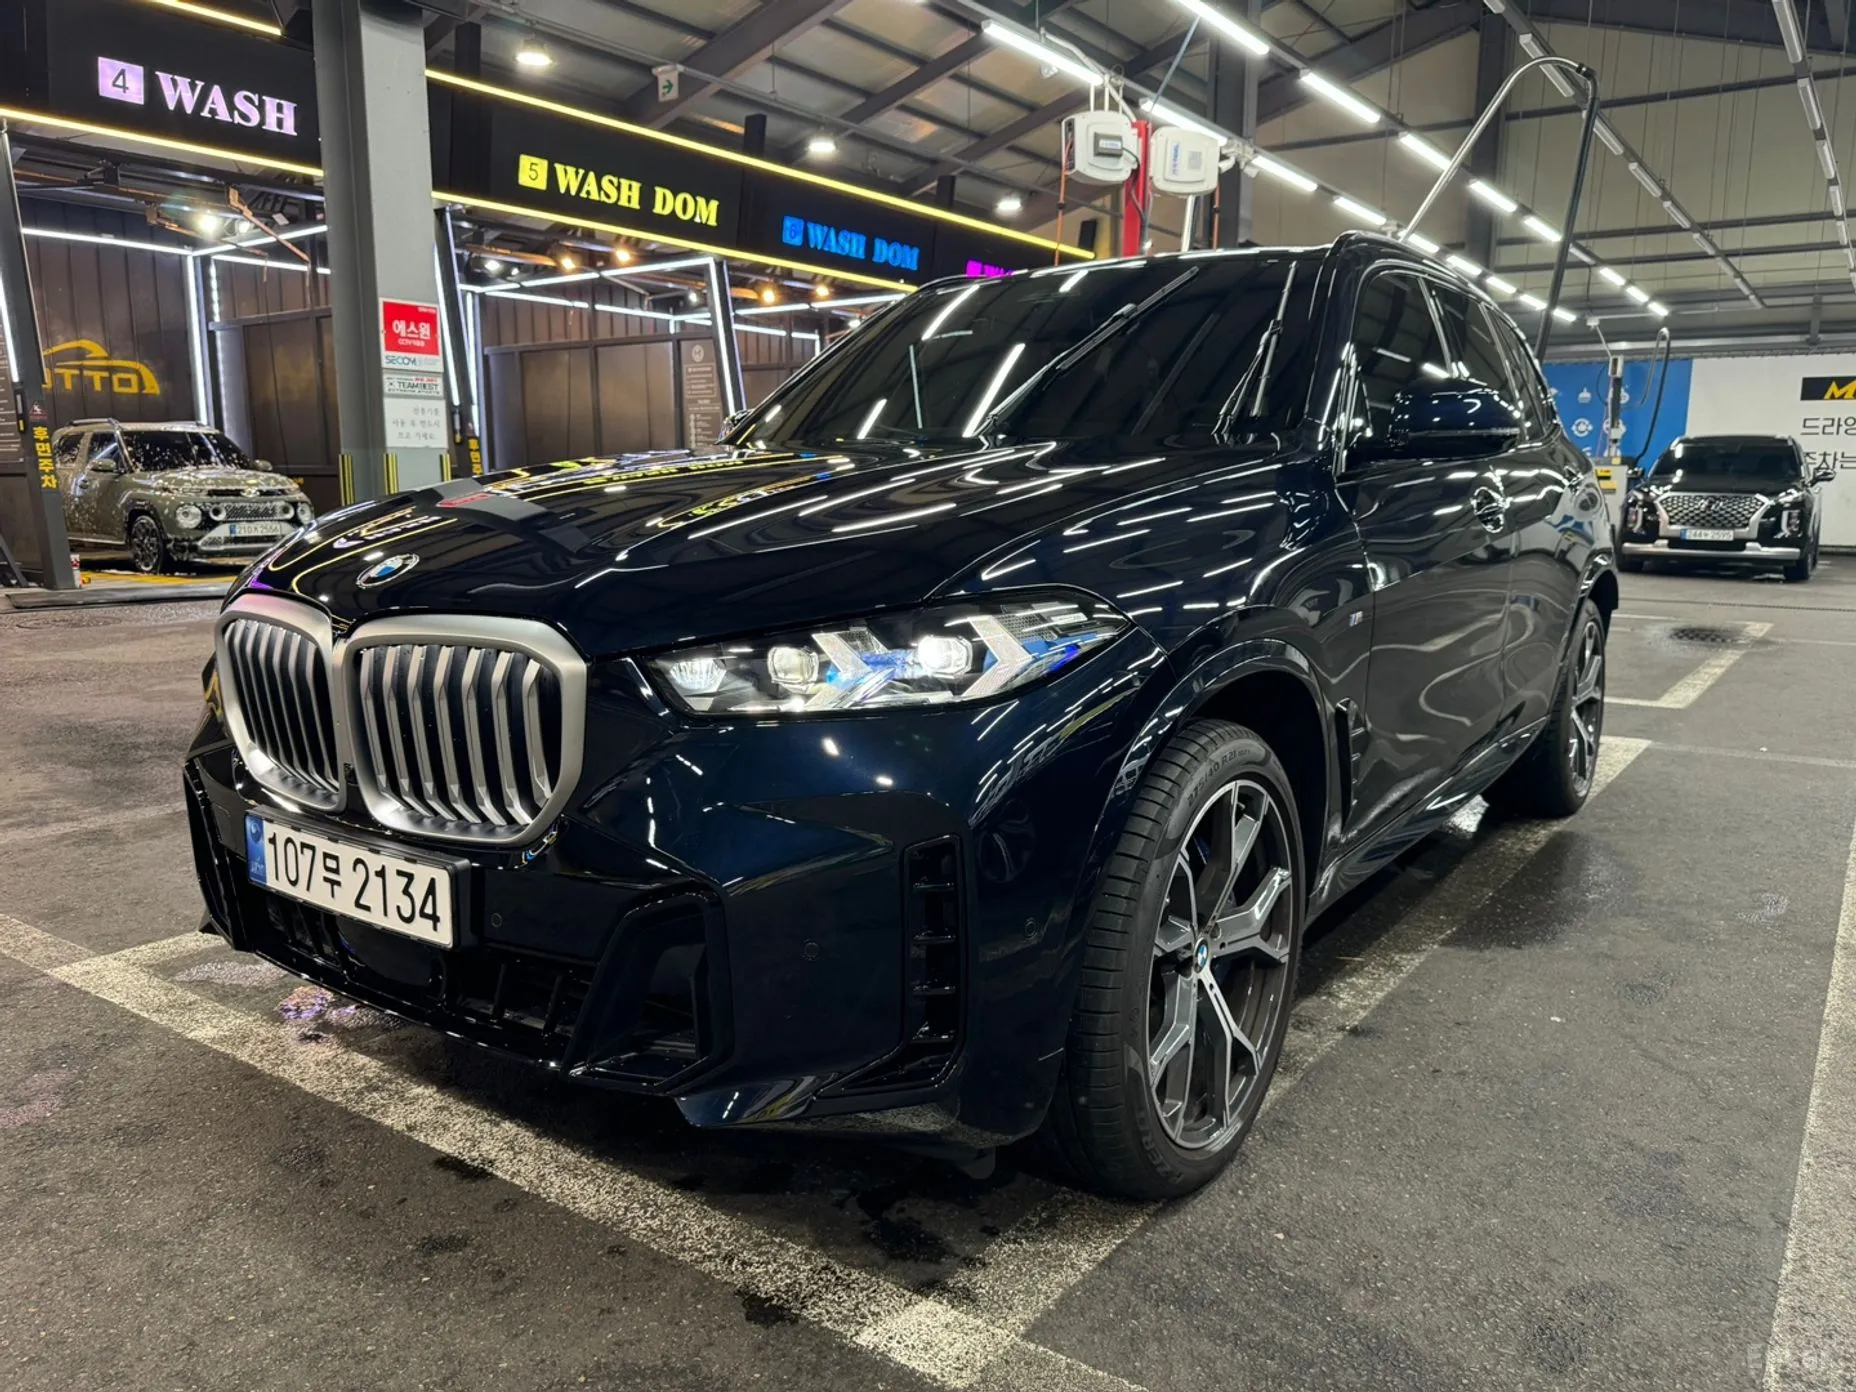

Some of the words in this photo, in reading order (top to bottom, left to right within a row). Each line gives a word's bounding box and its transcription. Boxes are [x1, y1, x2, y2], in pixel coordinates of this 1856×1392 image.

[111, 68, 129, 94] 4
[155, 71, 298, 136] WASH
[528, 162, 539, 181] 5
[553, 163, 642, 210] WASH
[652, 186, 720, 227] DOM
[806, 221, 866, 259] WASH
[872, 237, 920, 271] DOM
[392, 319, 431, 340] 에스원
[385, 355, 417, 366] SECOM
[33, 427, 58, 488] 후면주차
[268, 832, 342, 899] 107무
[352, 857, 441, 932] 2134
